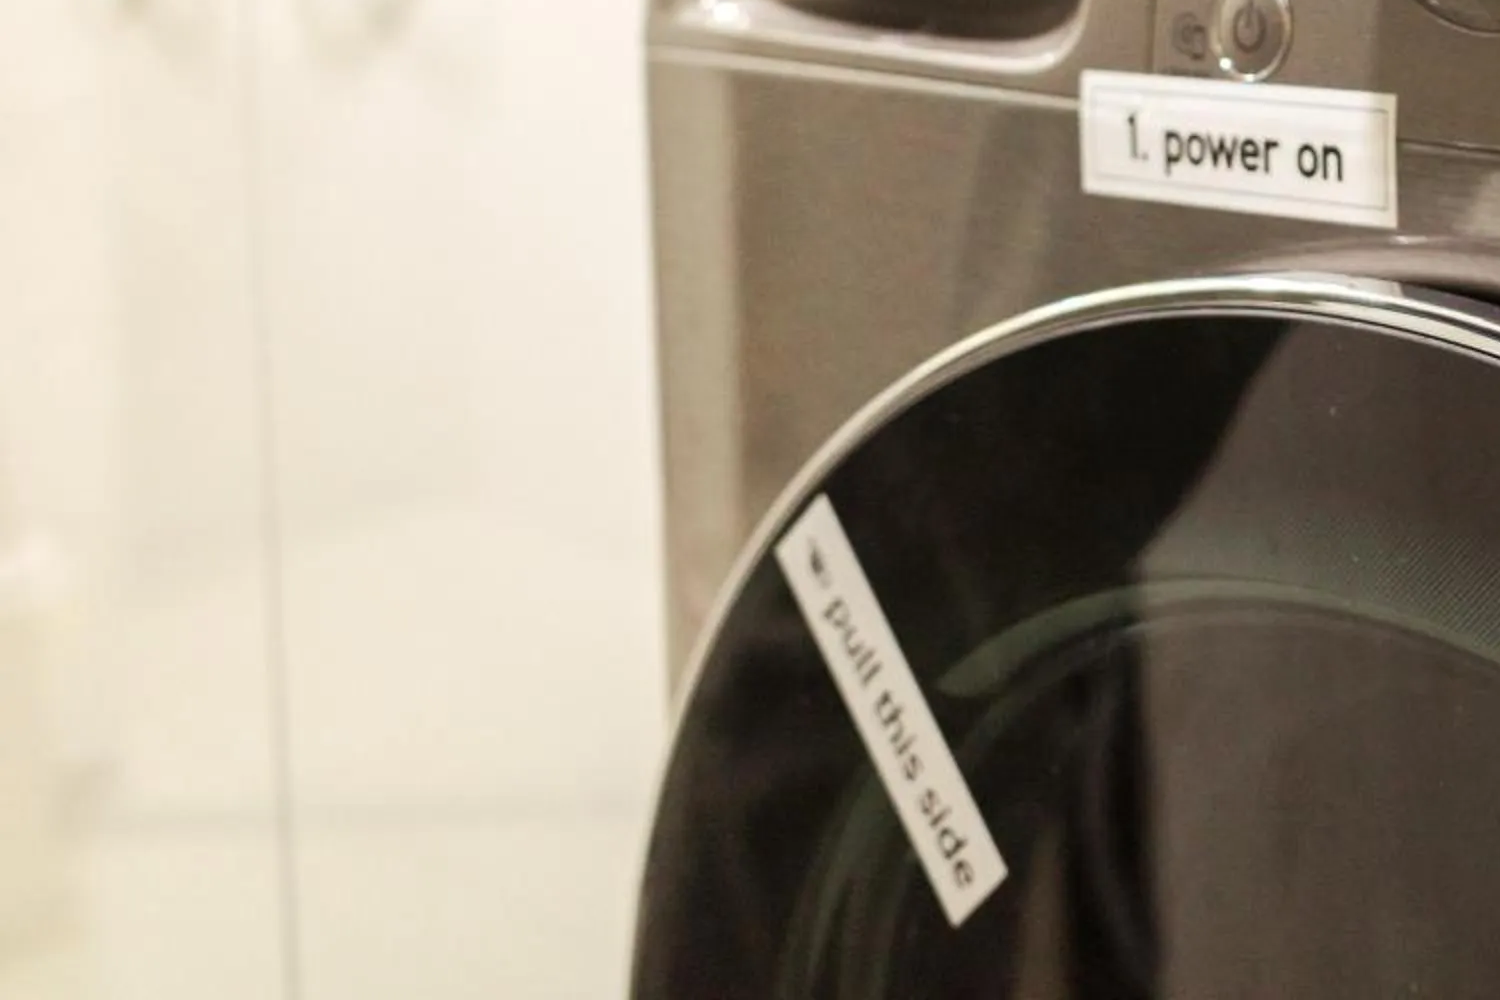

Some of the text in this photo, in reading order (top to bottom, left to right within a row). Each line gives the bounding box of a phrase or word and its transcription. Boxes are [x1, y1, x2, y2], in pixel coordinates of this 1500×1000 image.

[1127, 110, 1344, 182] 1. power on
[822, 599, 976, 889] pull this side
